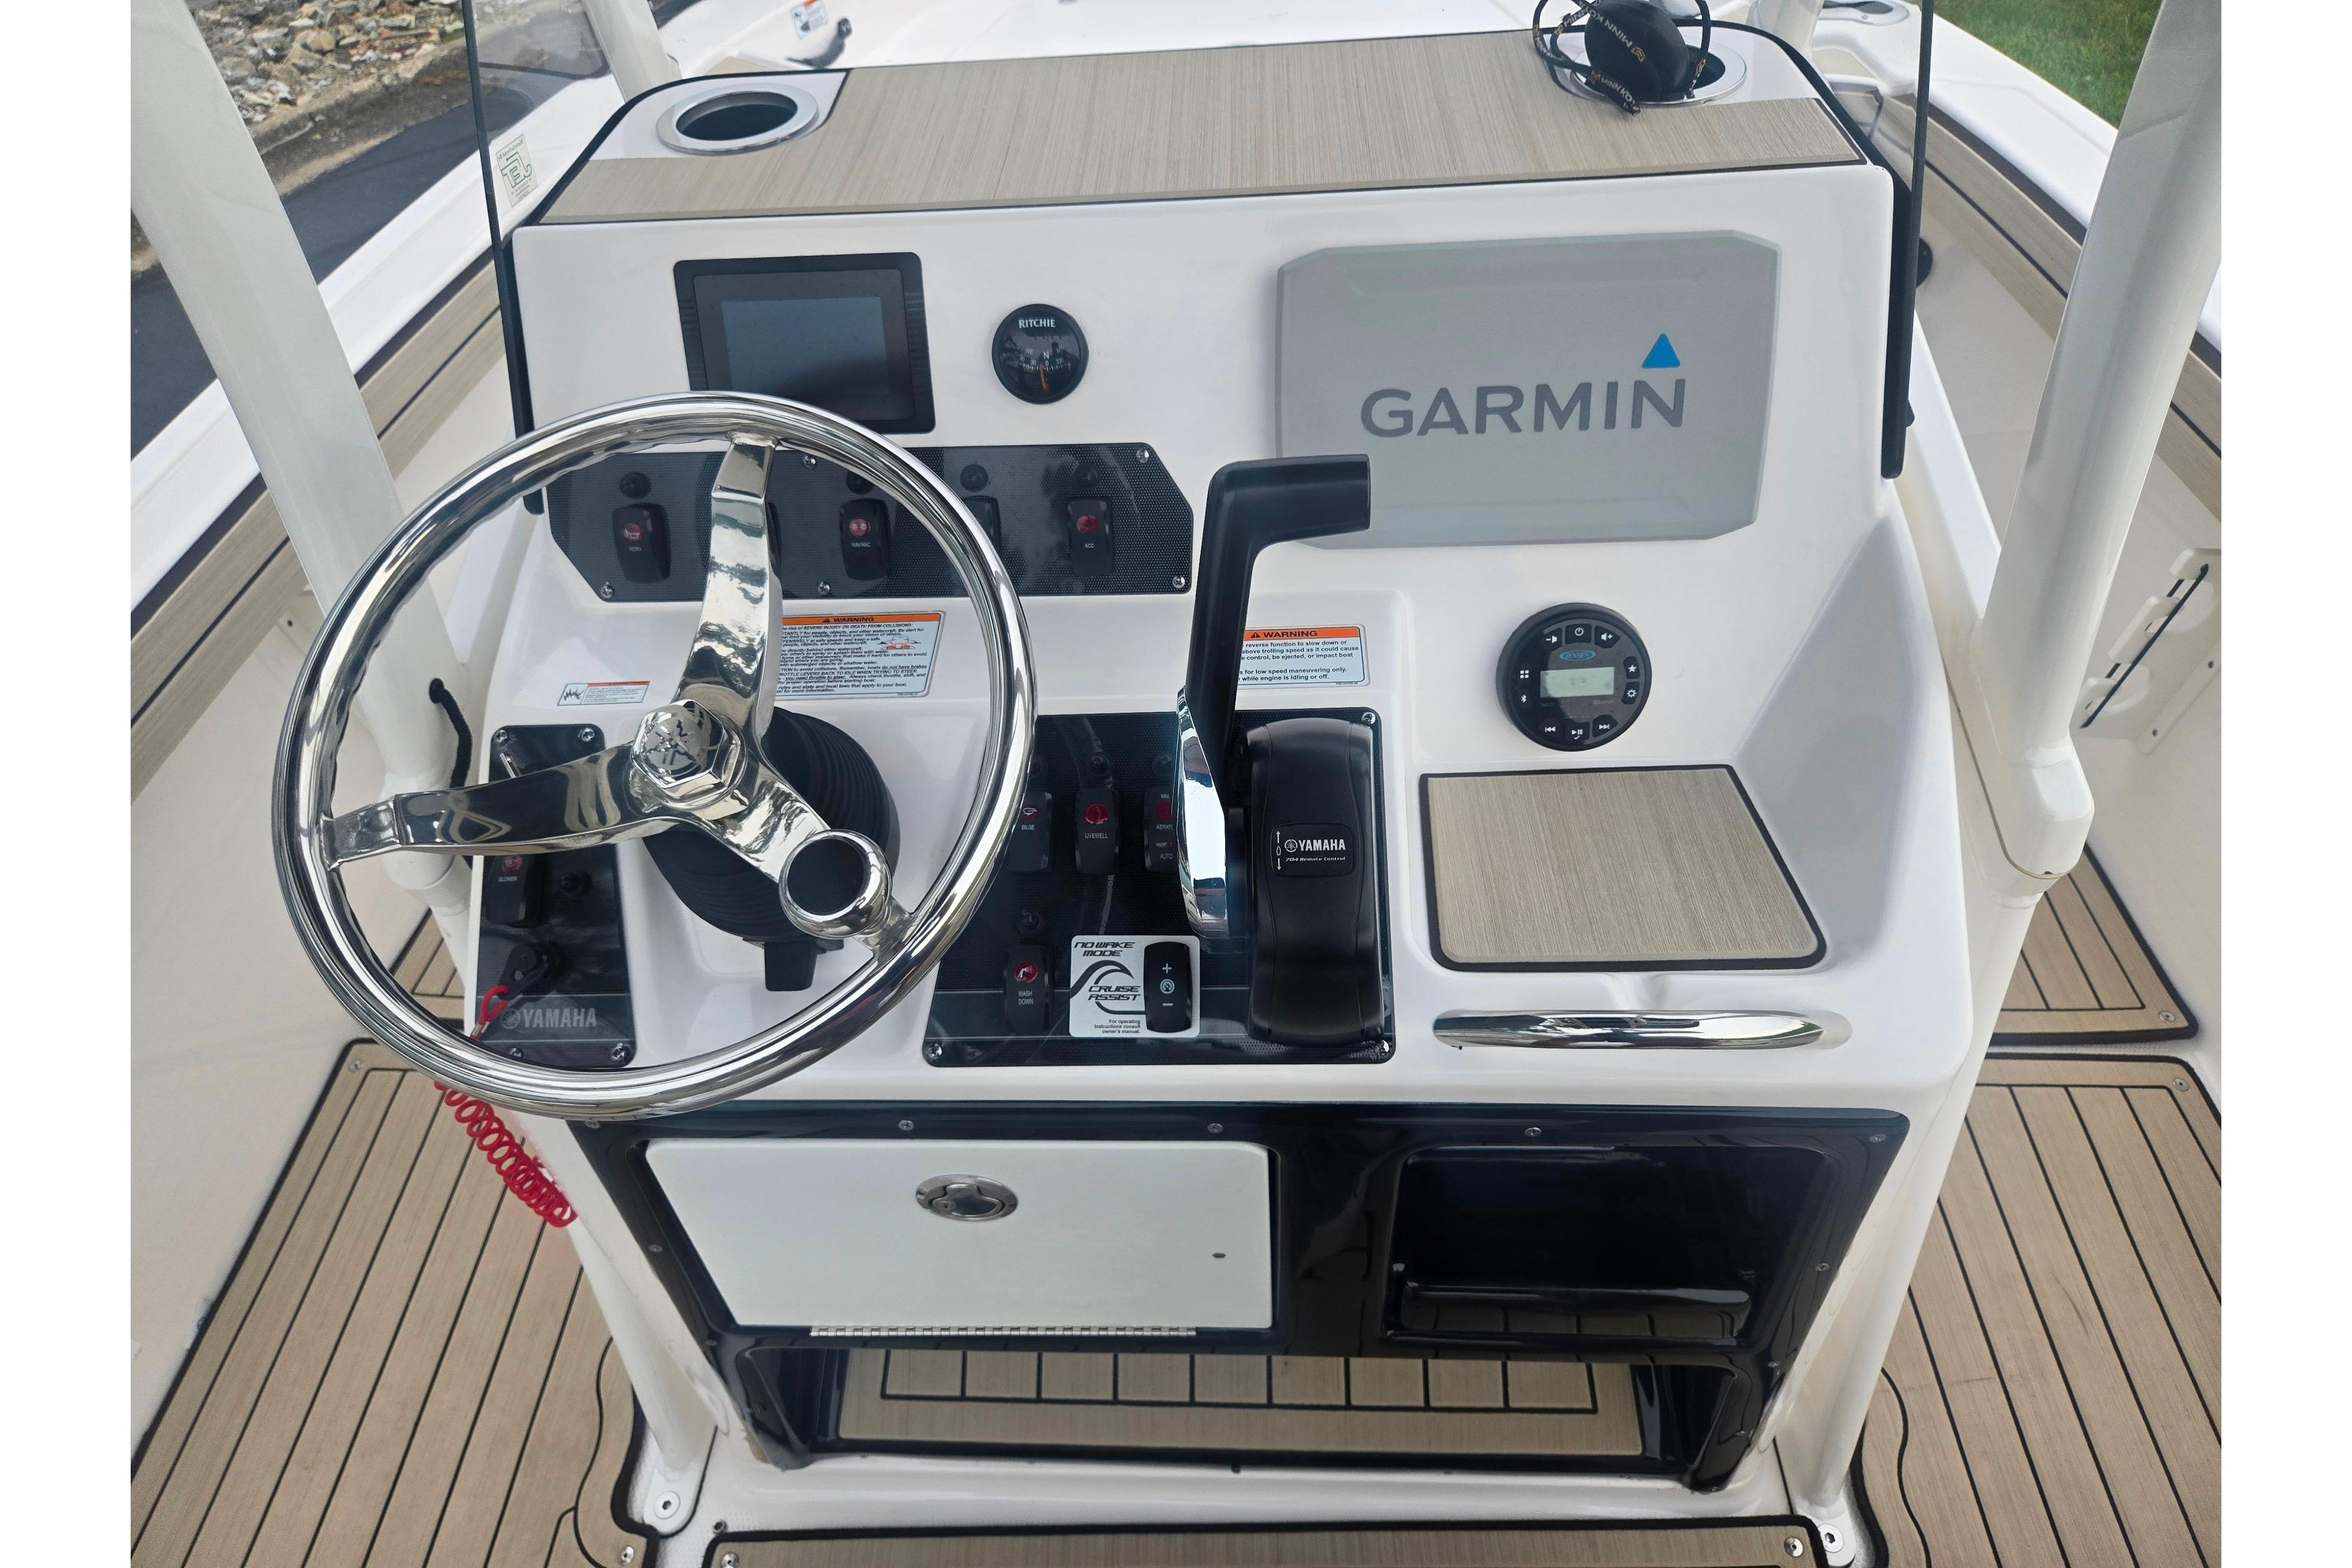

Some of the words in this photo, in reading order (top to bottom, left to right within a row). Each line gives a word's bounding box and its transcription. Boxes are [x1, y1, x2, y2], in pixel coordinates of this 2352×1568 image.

[1605, 19, 1632, 48] MINN
[1601, 77, 1621, 91] MINN
[1019, 319, 1056, 329] RITCHIE
[1361, 379, 1686, 437] GARMIN
[1298, 839, 1346, 851] YAMAHA
[523, 1007, 597, 1028] YAMAHA
